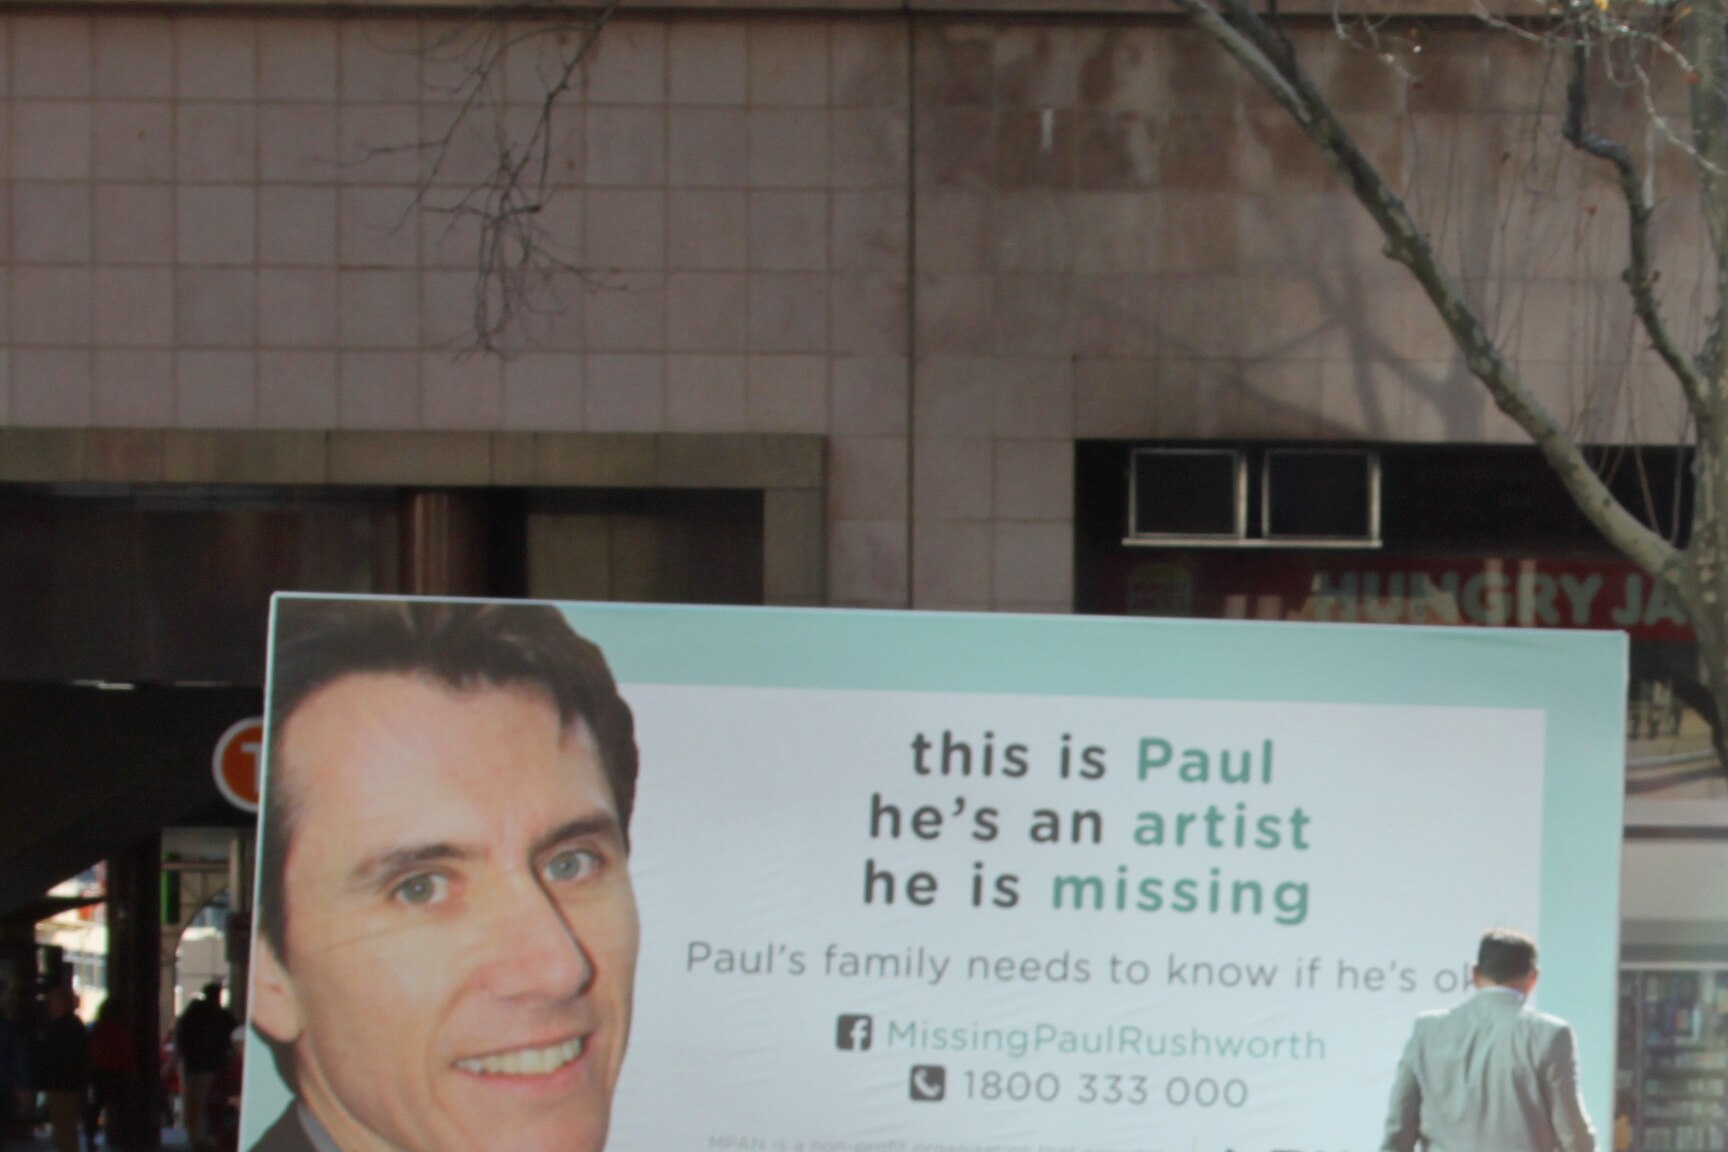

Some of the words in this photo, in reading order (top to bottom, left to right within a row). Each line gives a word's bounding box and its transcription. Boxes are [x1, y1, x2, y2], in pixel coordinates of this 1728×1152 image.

[1314, 571, 1603, 627] HUNGRY
[910, 729, 1029, 779] this
[1059, 732, 1106, 781] is
[1137, 737, 1273, 784] Paul
[869, 792, 999, 842] he's
[1028, 808, 1102, 844] an
[1133, 802, 1311, 851] artist
[863, 858, 938, 907] he
[971, 860, 1019, 909] is
[1052, 865, 1309, 926] missing
[686, 940, 806, 976] Paul's
[823, 943, 950, 986] family
[967, 951, 1091, 983] needs
[1109, 954, 1150, 985] to
[1167, 953, 1278, 988] know
[1295, 956, 1321, 988] if
[1337, 958, 1417, 993] he's
[887, 1019, 1326, 1061] MissingPaulRushworth
[965, 1070, 1060, 1102] 1800
[1077, 1073, 1147, 1105] 333
[1165, 1076, 1249, 1109] 000
[706, 1135, 766, 1151] MPAN
